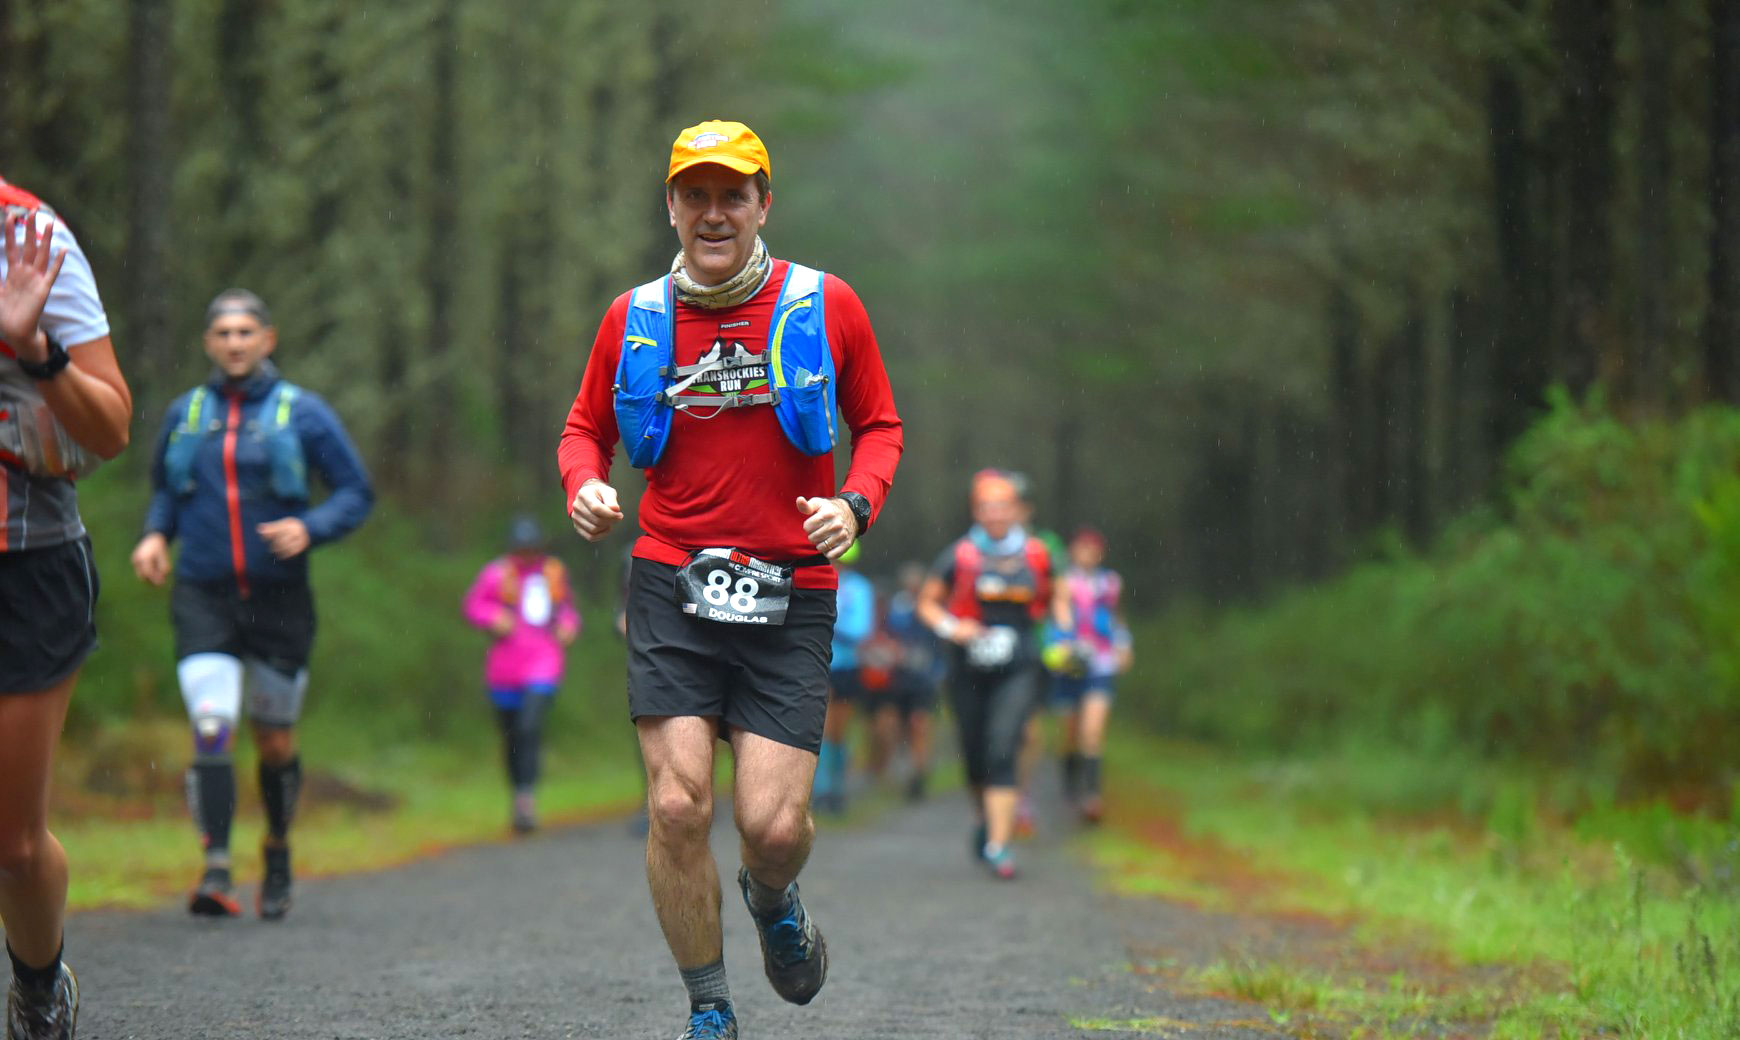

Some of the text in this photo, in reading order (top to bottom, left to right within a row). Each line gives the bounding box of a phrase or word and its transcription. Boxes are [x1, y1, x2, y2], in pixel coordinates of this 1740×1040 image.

[720, 379, 742, 392] RUN
[702, 569, 759, 613] 88
[708, 607, 768, 623] DOUGLAS
